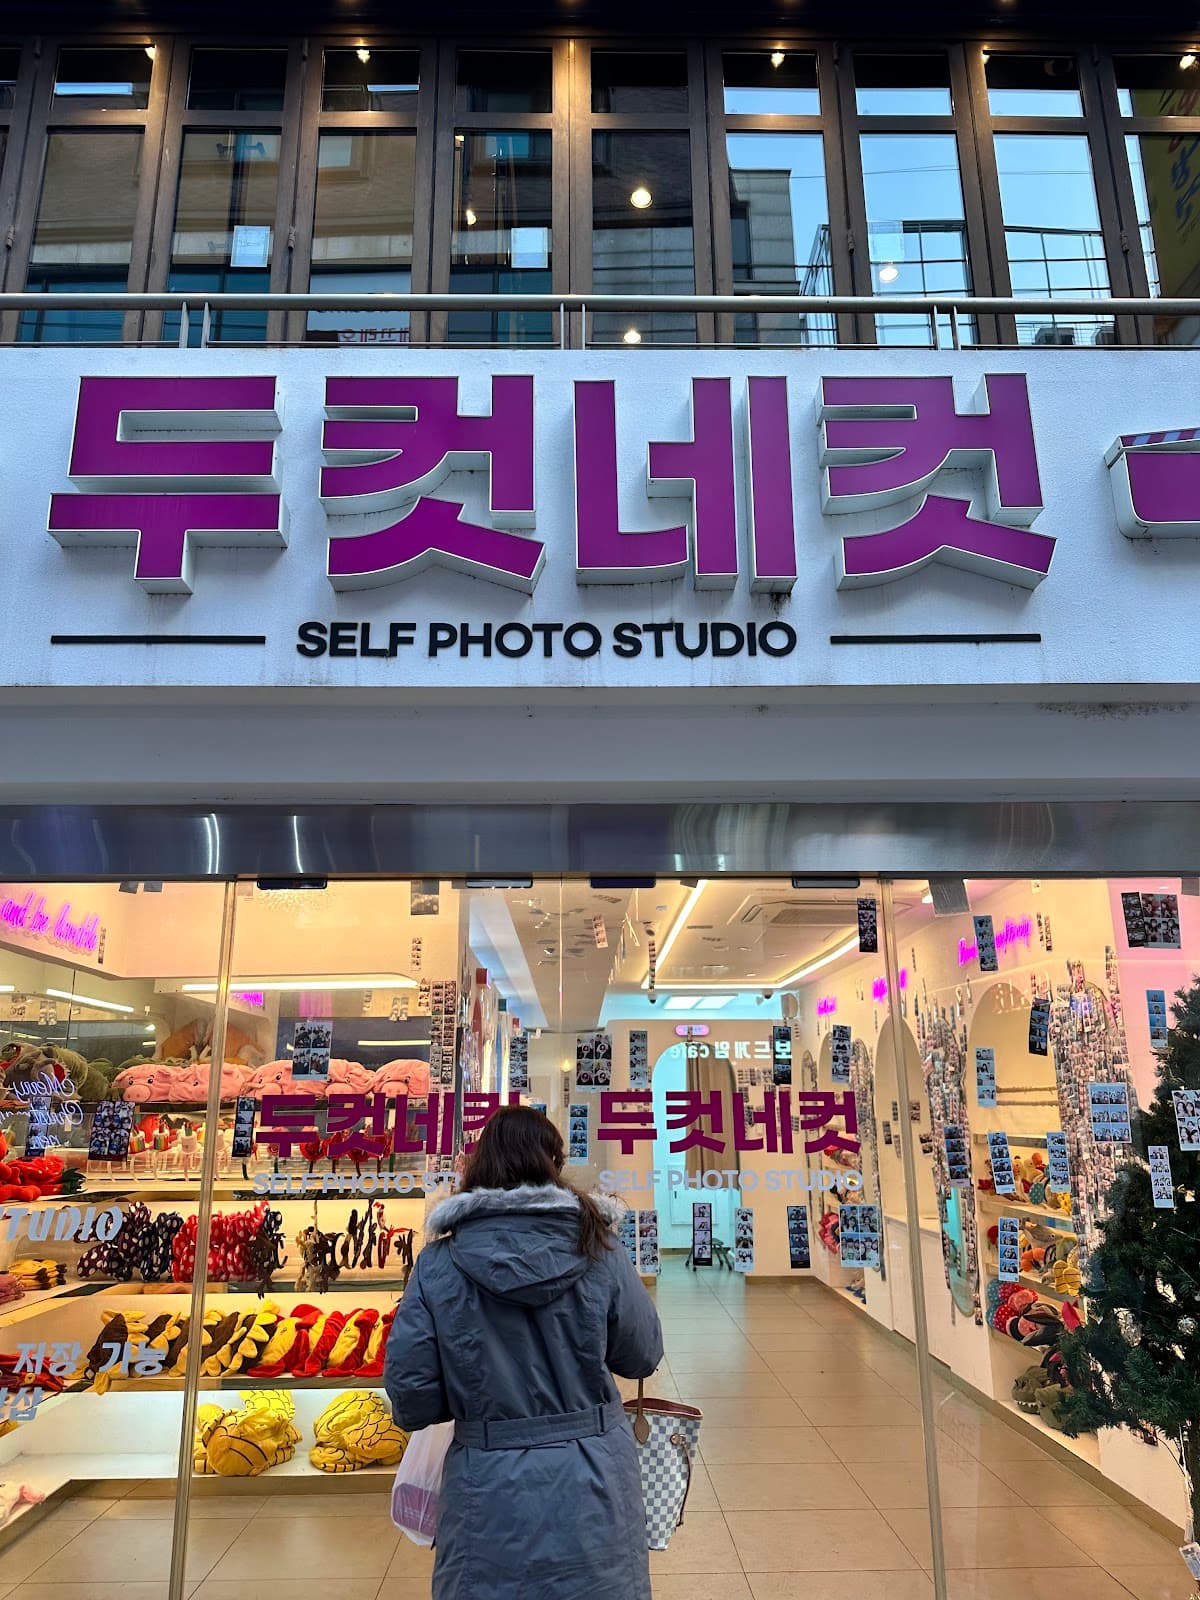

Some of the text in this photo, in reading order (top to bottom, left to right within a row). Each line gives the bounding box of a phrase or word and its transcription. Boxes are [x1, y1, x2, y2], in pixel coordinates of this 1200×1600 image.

[48, 373, 1057, 595] 두컷네컷
[297, 622, 797, 658] SELF PHOTO STUDIO
[598, 1090, 861, 1155] 두컷네컷
[253, 1173, 317, 1195] SELF
[322, 1172, 415, 1194] PHOTO
[599, 1170, 863, 1191] SELF PHOTO STUDIO
[12, 1341, 166, 1376] 저장 가능
